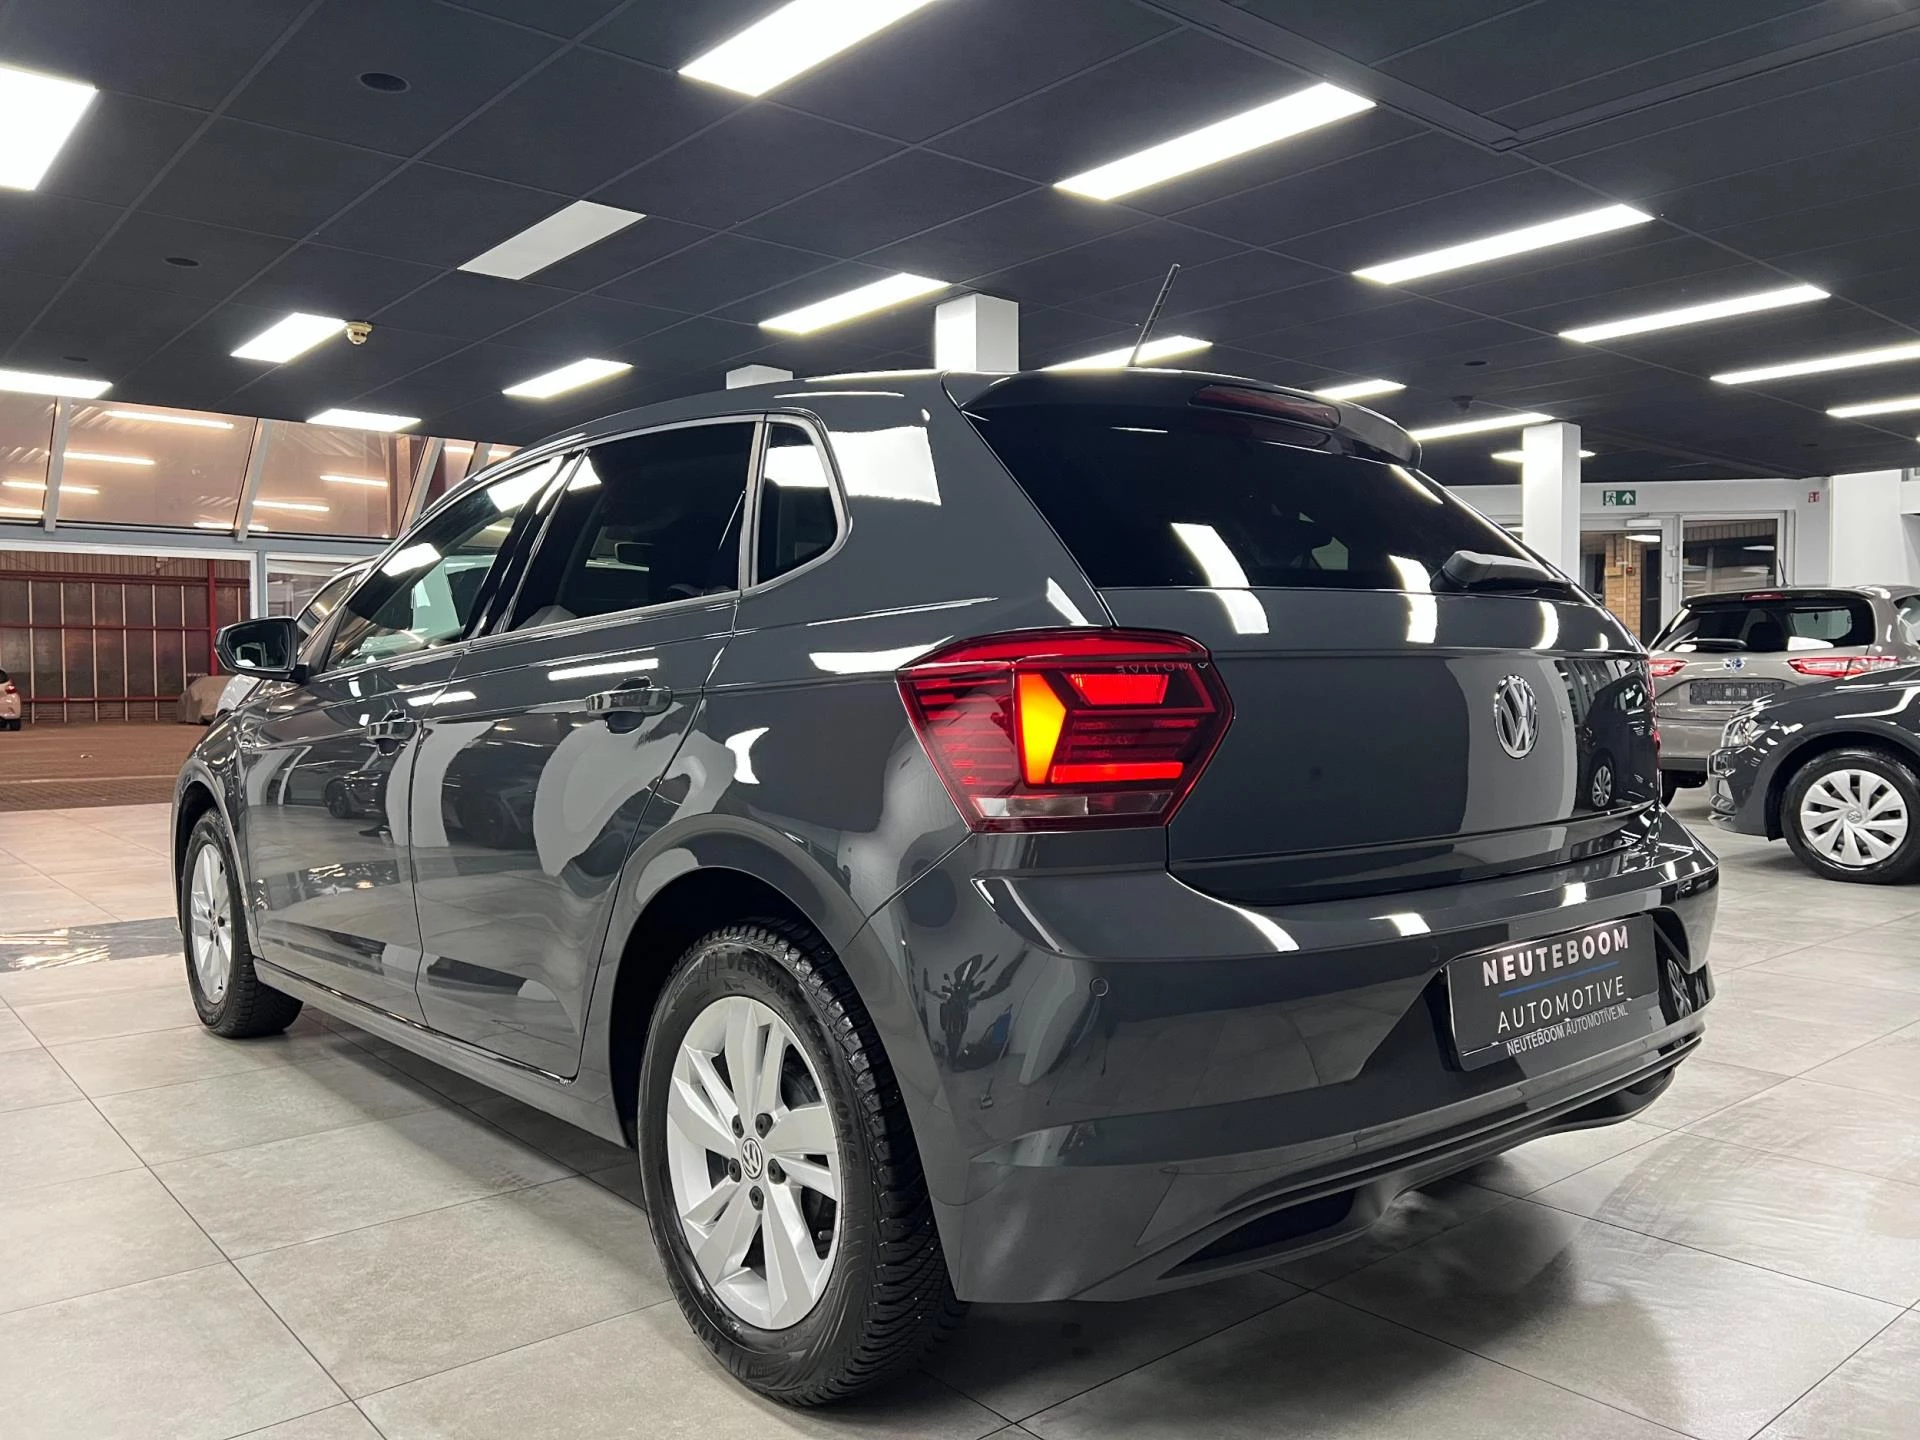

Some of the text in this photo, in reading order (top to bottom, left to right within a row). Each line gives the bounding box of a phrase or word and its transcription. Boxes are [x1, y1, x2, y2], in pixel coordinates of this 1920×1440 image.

[1494, 675, 1539, 758] VW
[1482, 925, 1629, 987] NEUTEBOOM
[1498, 976, 1625, 1034] AUTOMOTIVE
[1506, 1003, 1629, 1056] NEUTEBOOM AUTOMOTIVE.NL
